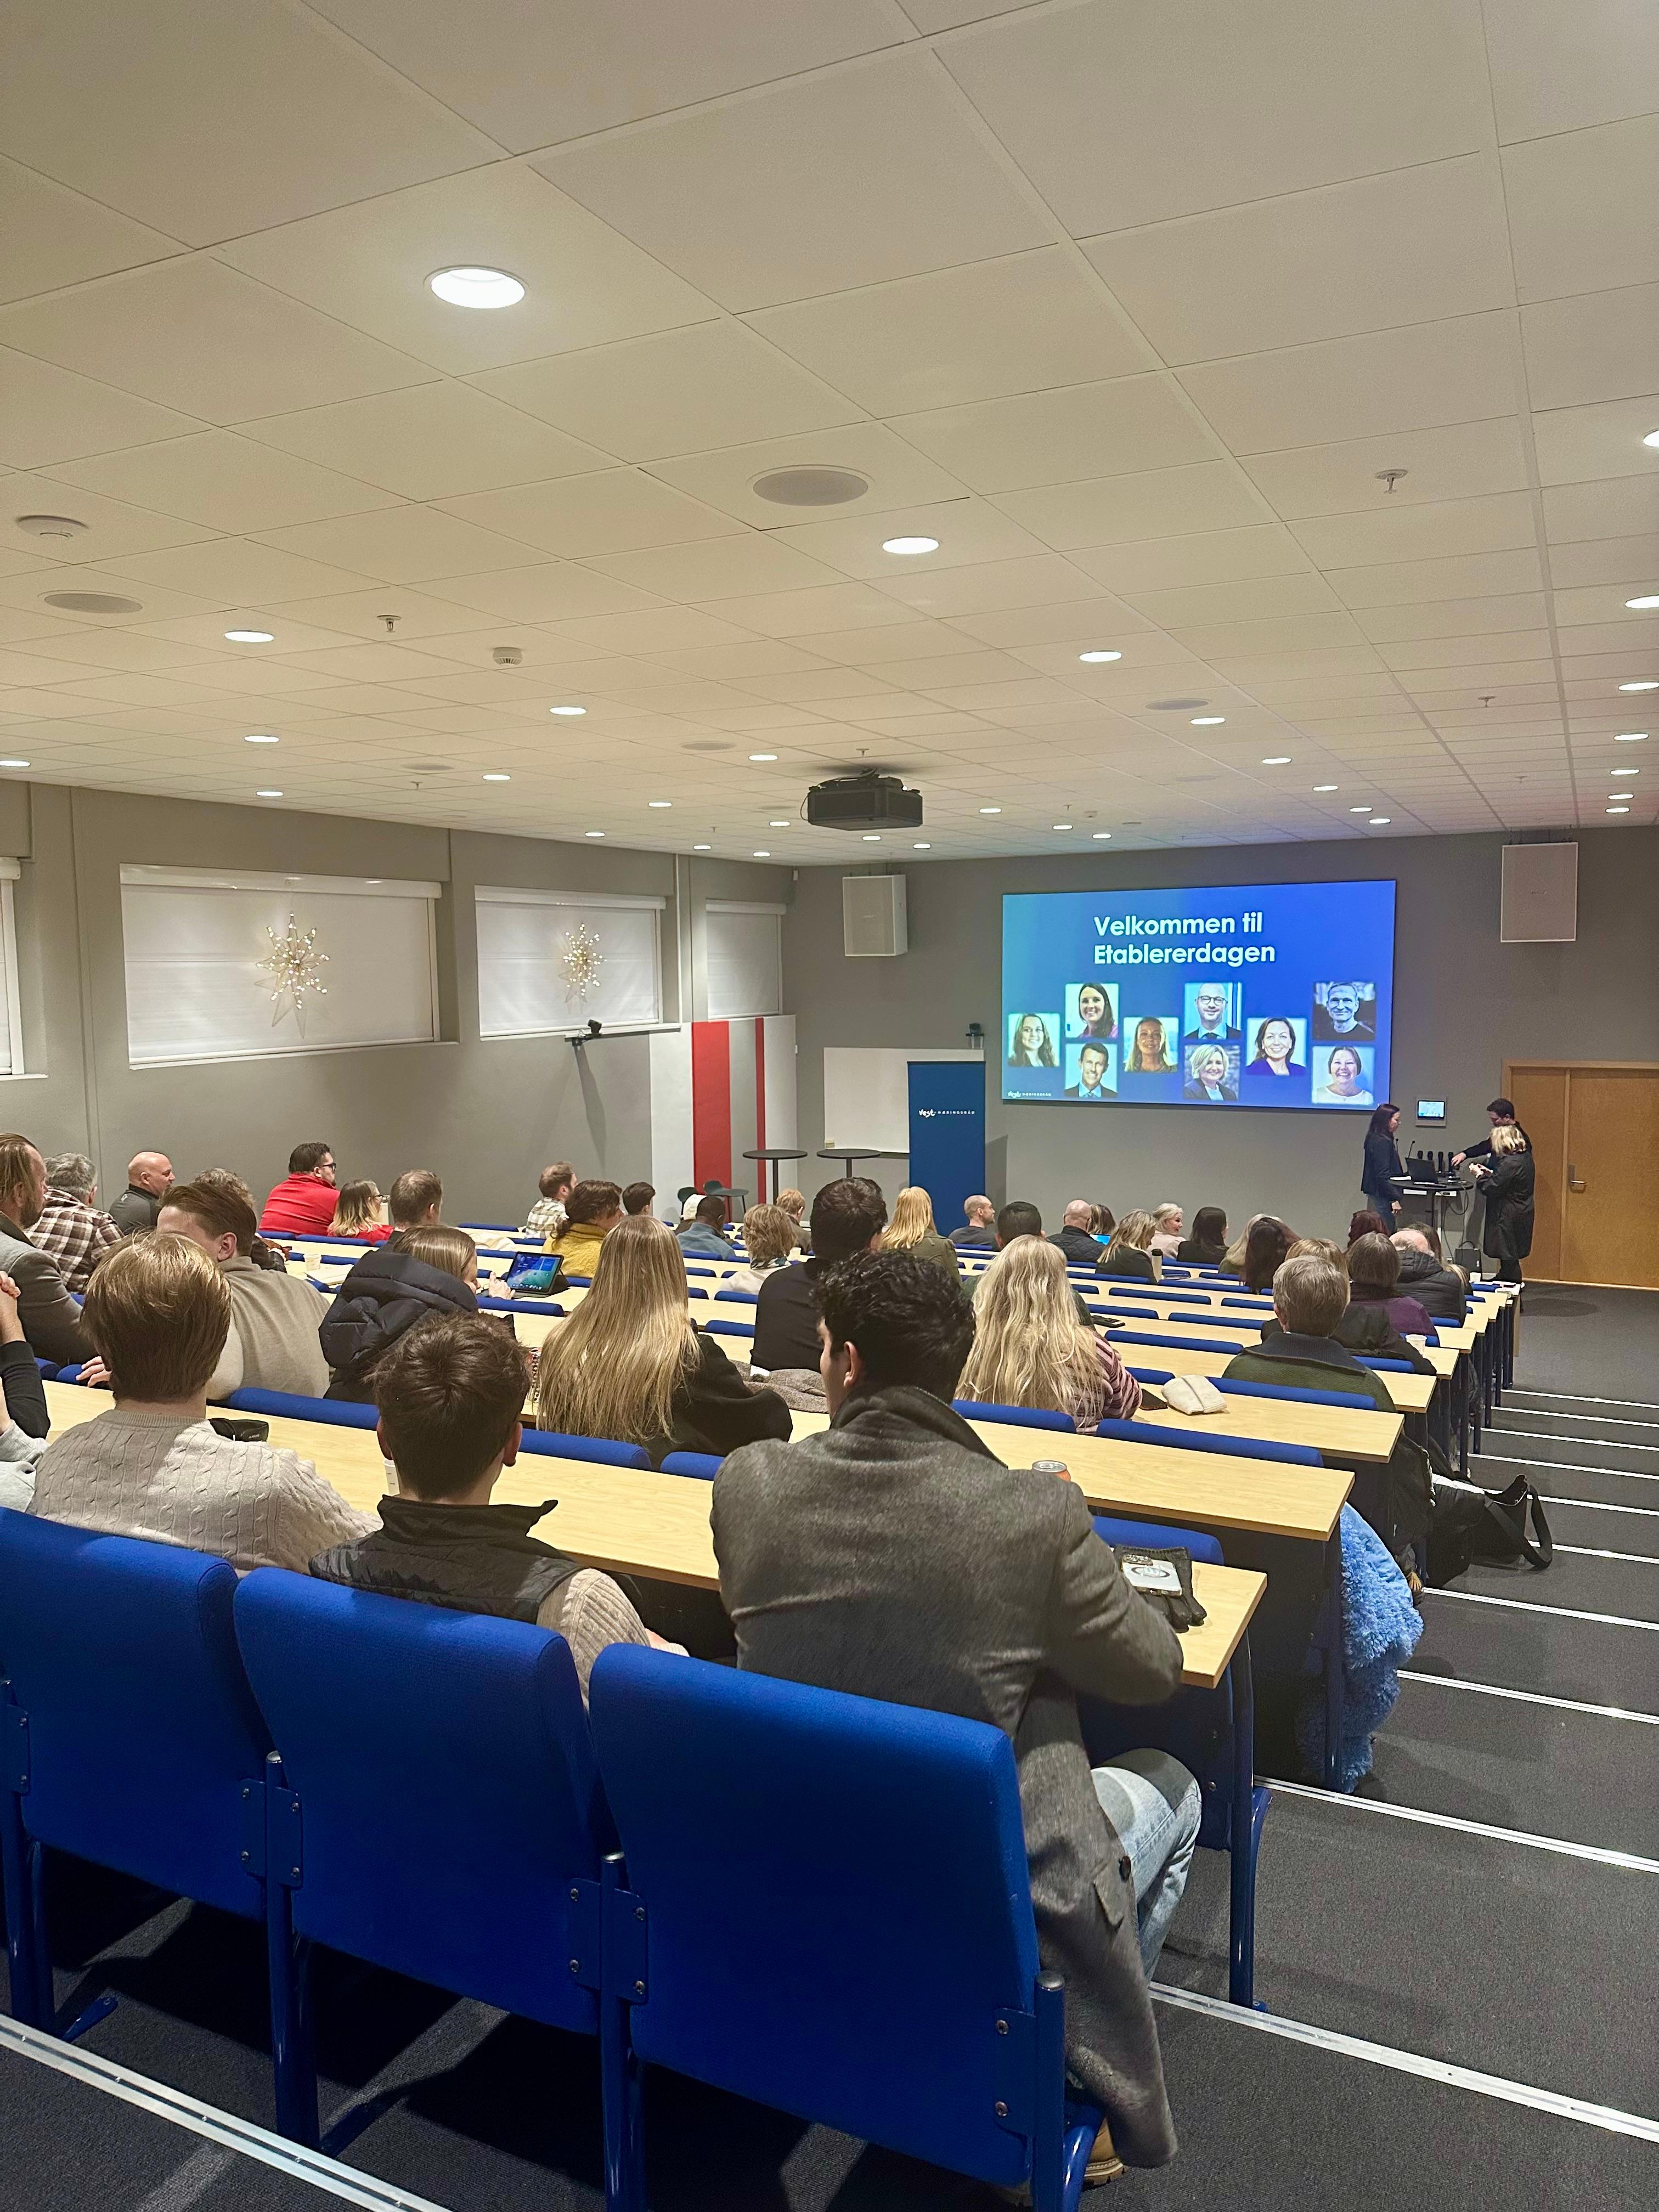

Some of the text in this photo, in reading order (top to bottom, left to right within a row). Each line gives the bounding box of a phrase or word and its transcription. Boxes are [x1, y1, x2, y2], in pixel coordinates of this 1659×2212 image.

[1093, 911, 1263, 936] Velkommen til
[1093, 943, 1276, 967] Etablererdagen
